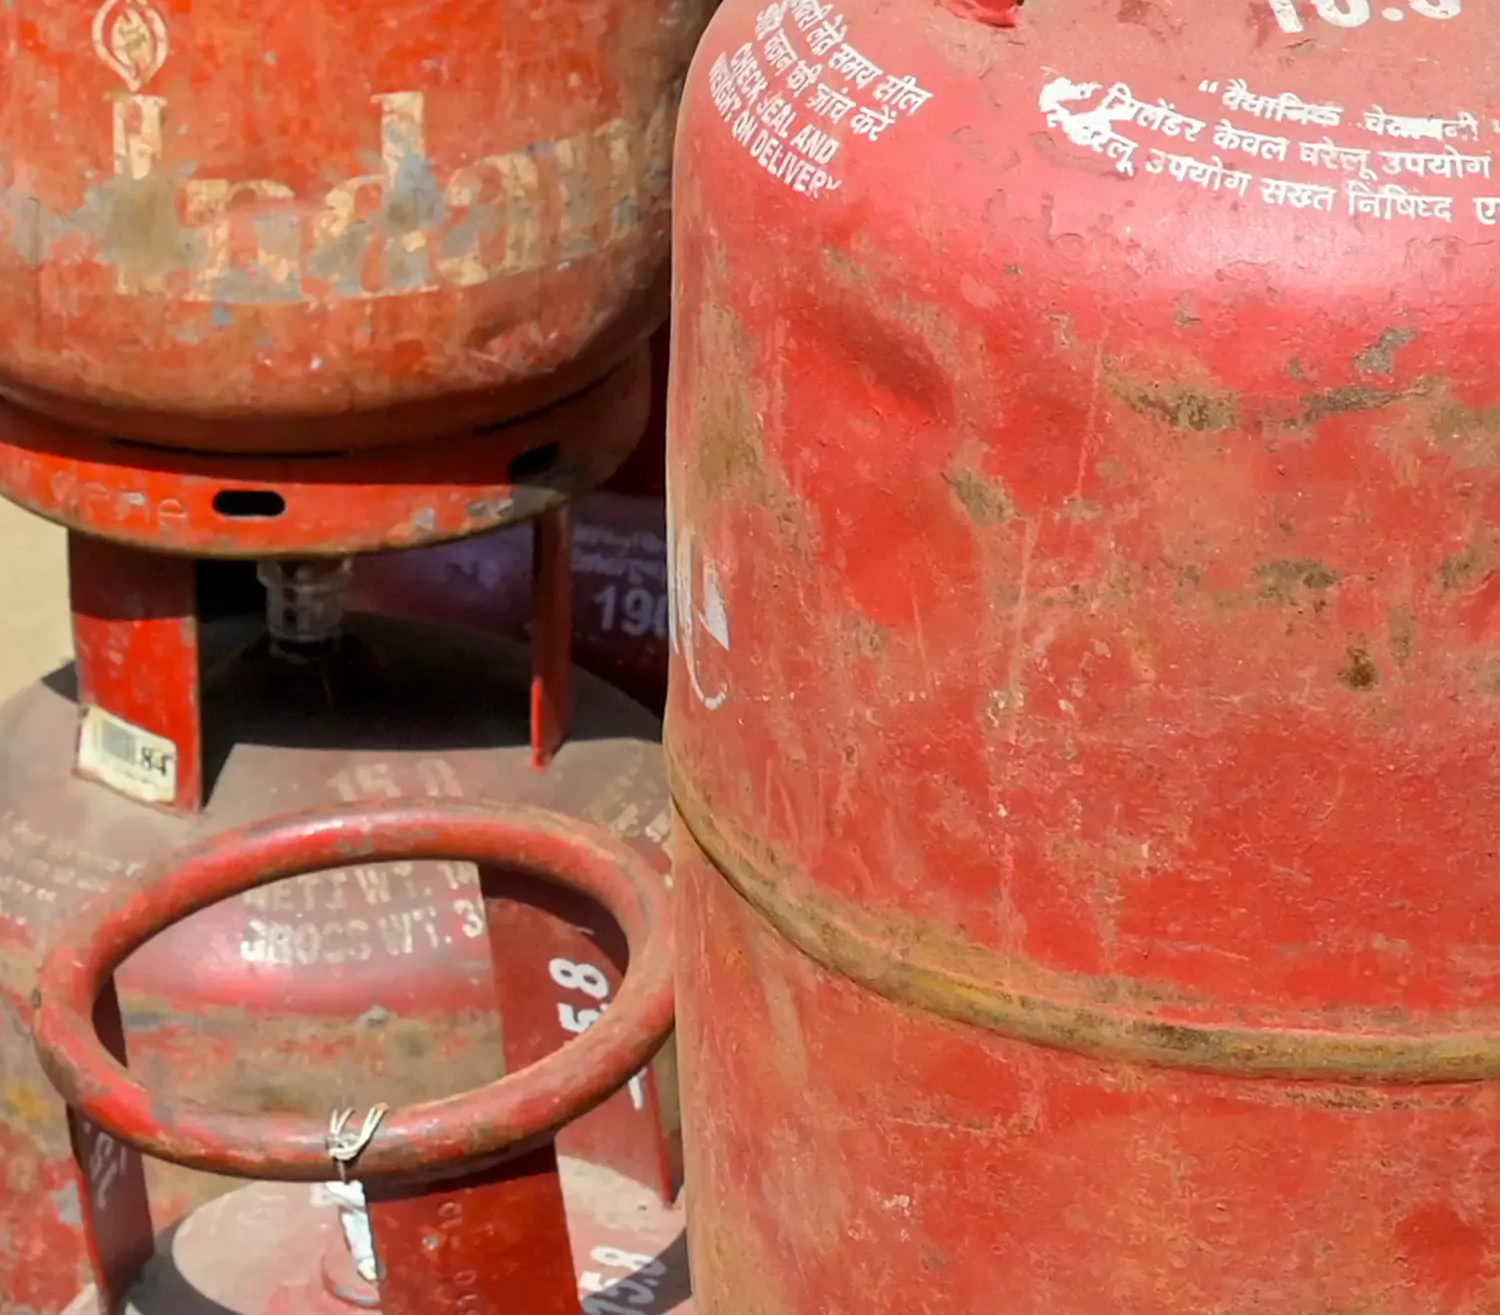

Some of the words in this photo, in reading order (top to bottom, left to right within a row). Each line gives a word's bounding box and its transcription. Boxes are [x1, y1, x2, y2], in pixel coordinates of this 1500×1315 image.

[871, 73, 935, 116] सील
[731, 108, 760, 148] ON
[789, 122, 840, 165] AND
[1212, 118, 1291, 162] केवल
[1377, 143, 1492, 180] उपयोग
[1144, 147, 1254, 198] उपयोग
[1259, 176, 1338, 213] सख्त
